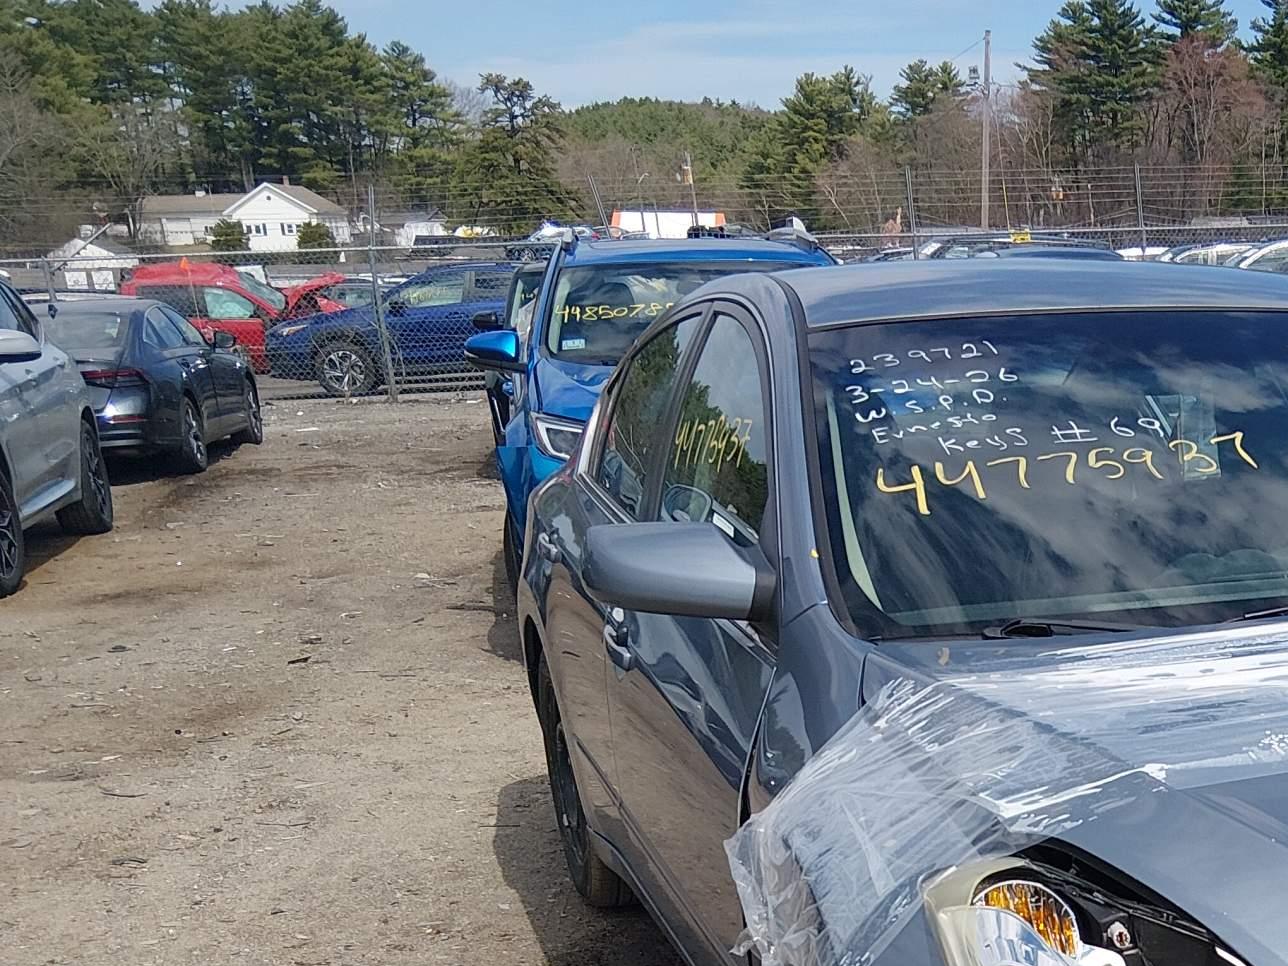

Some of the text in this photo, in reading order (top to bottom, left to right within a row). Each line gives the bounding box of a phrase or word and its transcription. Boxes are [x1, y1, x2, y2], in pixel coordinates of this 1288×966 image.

[849, 339, 998, 374] 239721
[845, 367, 1018, 404] 3-24-26
[1110, 416, 1165, 437] 69
[874, 431, 1258, 515] 44775937
